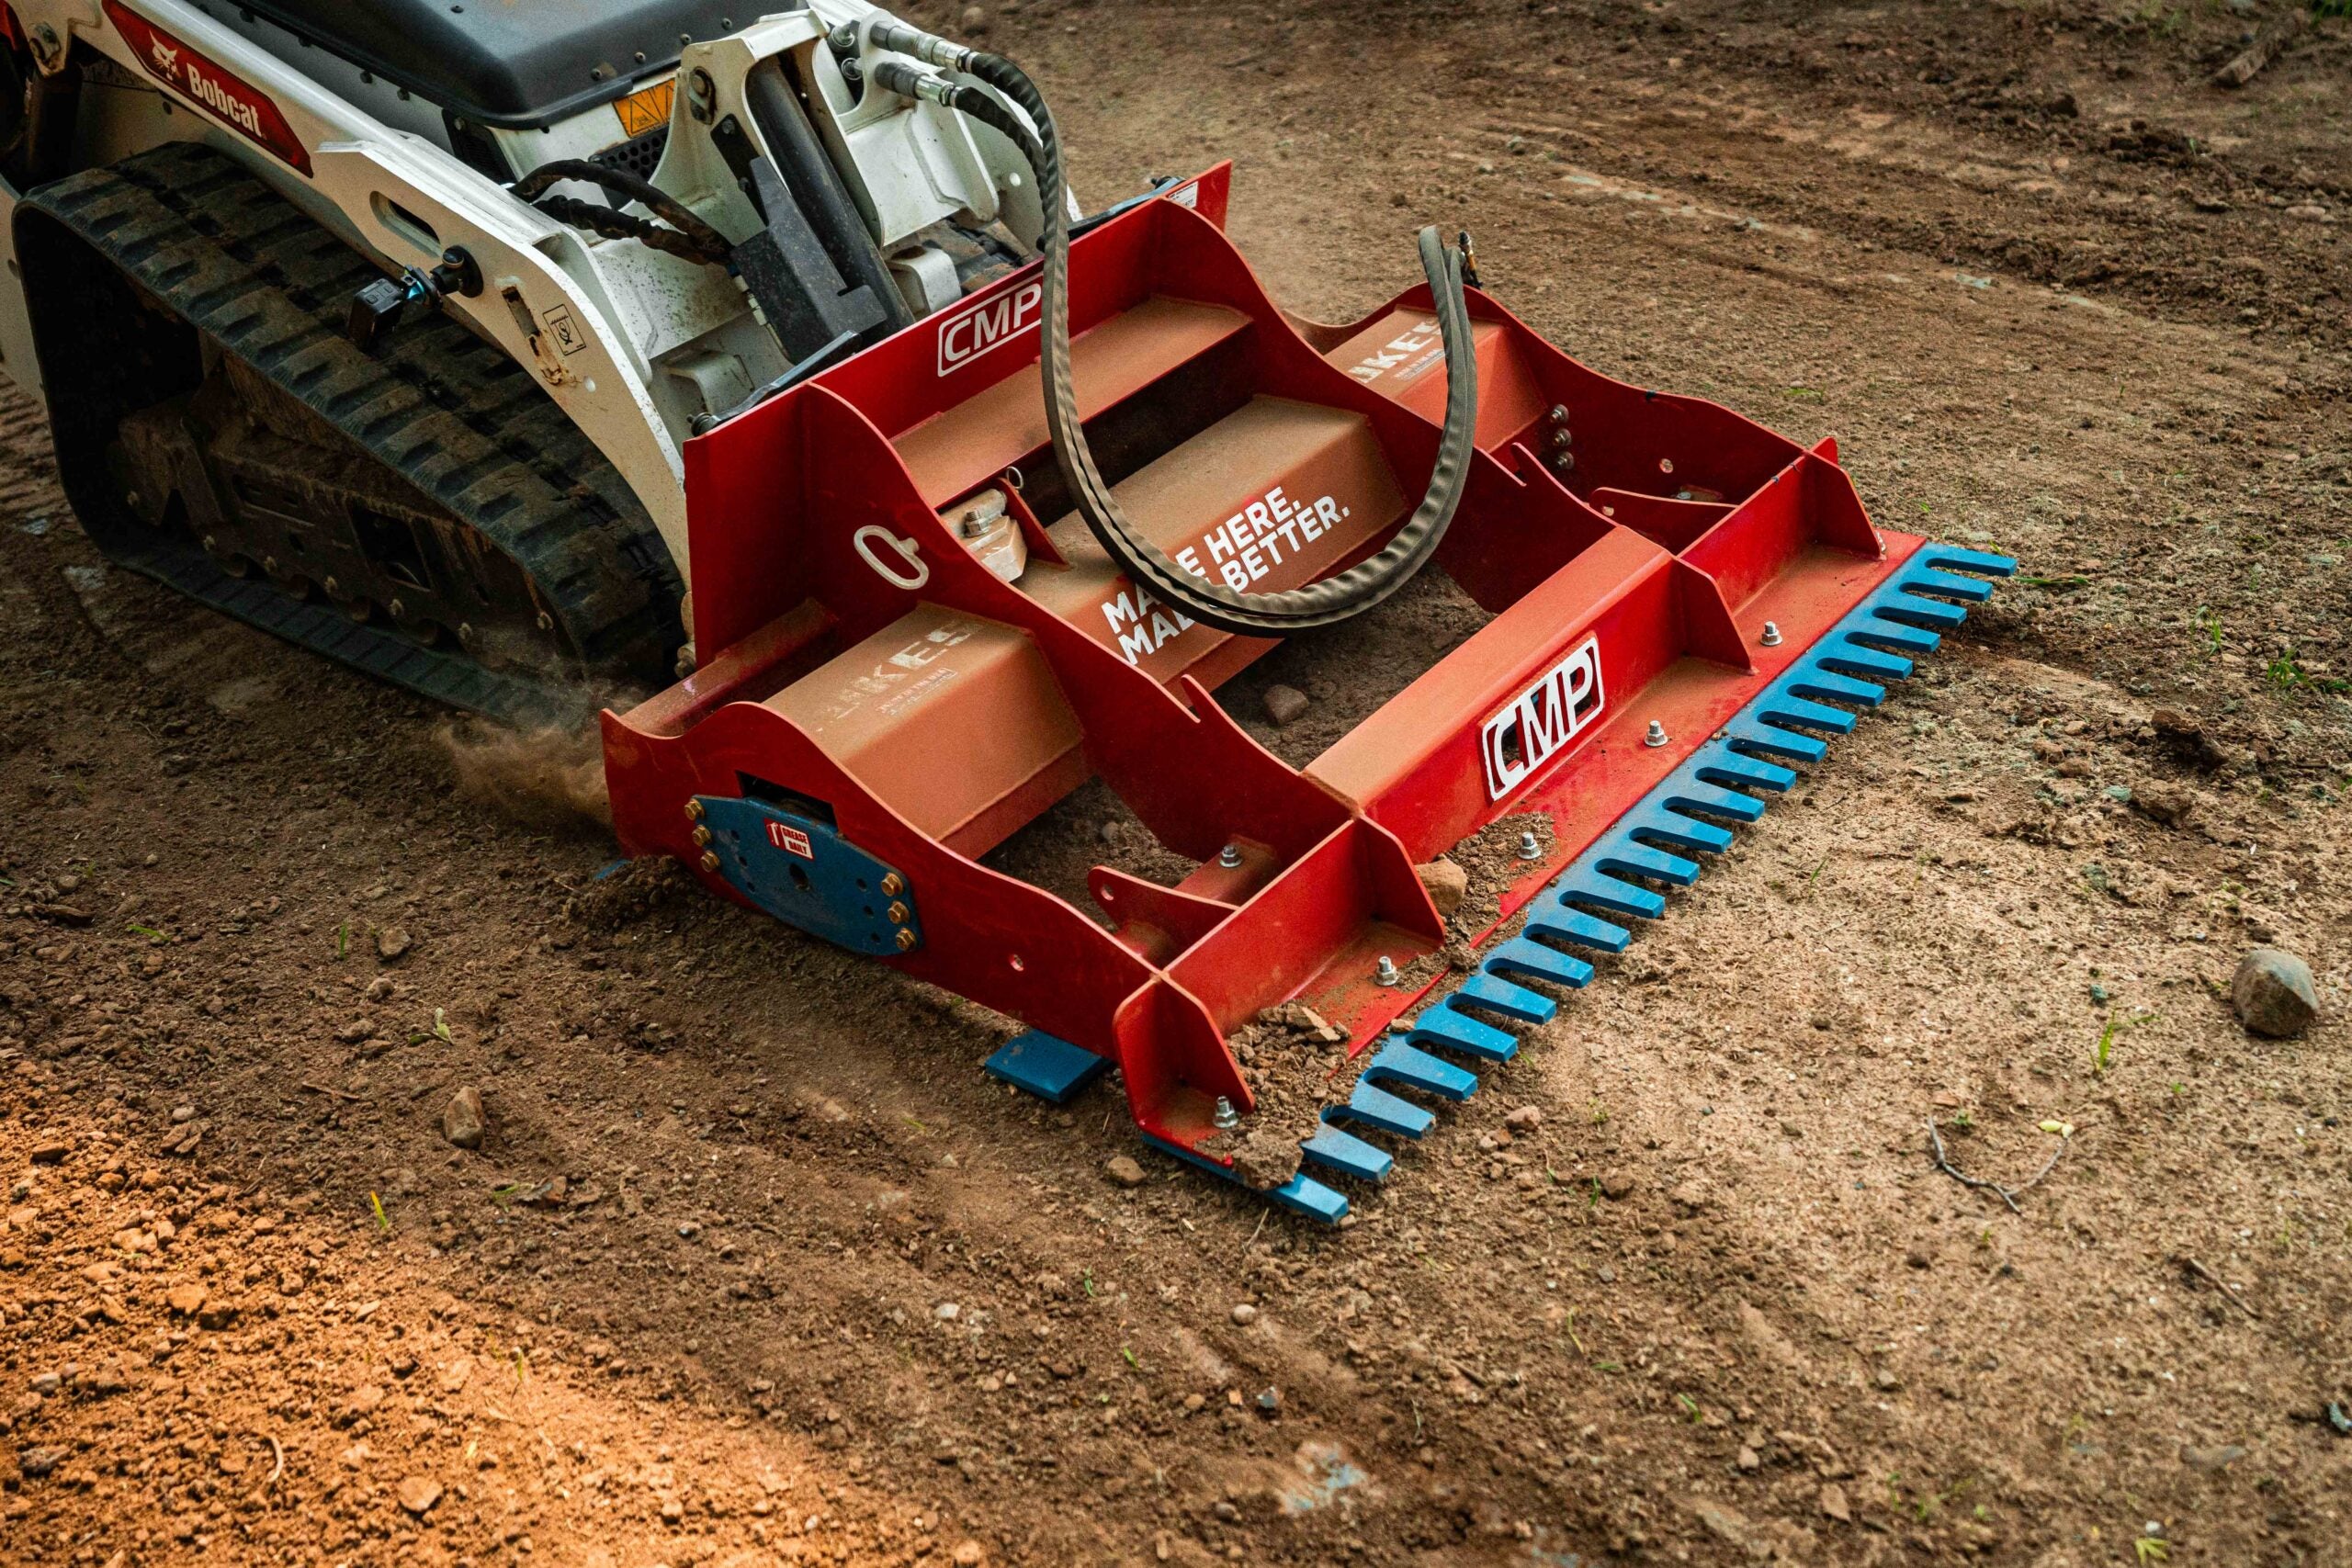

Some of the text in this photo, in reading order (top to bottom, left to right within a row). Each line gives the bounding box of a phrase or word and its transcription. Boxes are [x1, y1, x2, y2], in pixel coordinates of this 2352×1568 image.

[187, 62, 262, 138] Bobcat
[944, 283, 1042, 362] CMP
[1101, 486, 1302, 635] MAE HERE.
[1219, 495, 1351, 594] BETTER.
[1493, 641, 1594, 788] CMP
